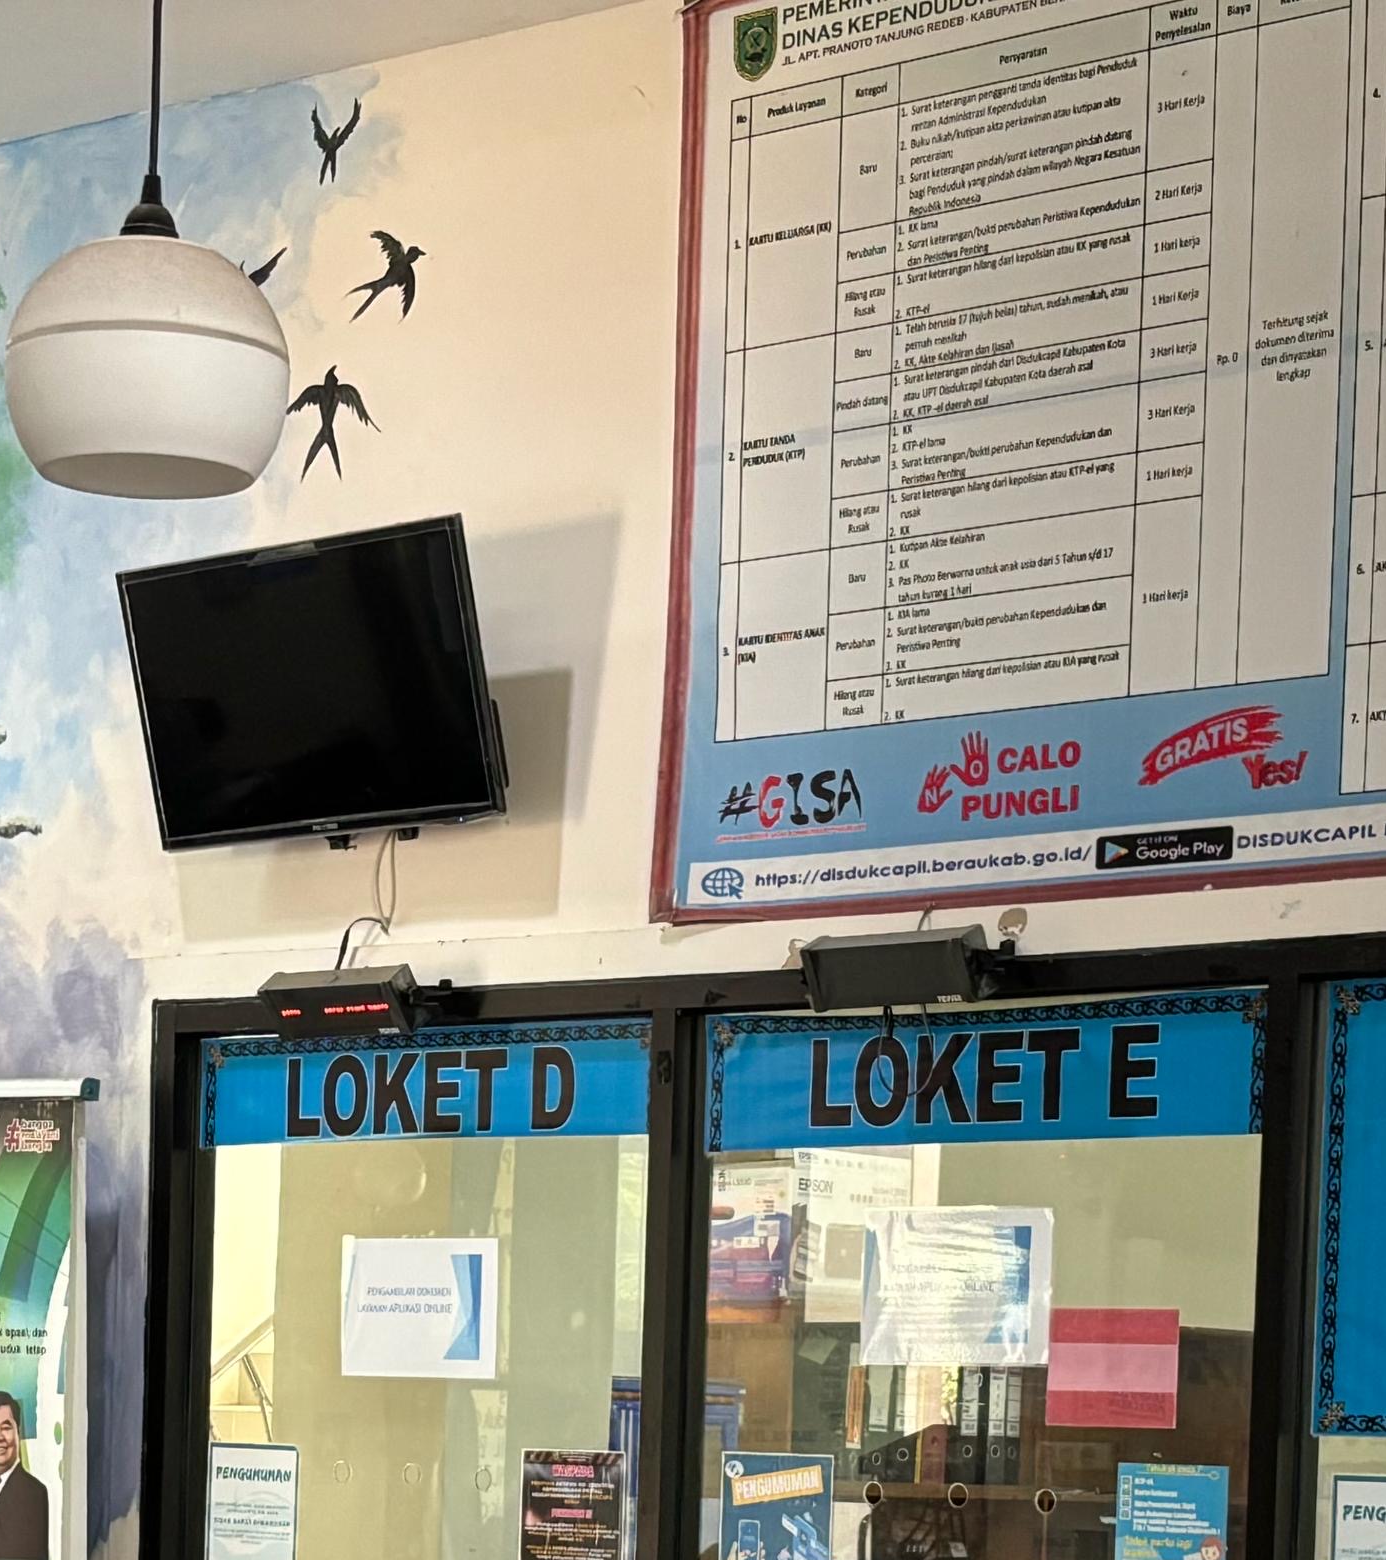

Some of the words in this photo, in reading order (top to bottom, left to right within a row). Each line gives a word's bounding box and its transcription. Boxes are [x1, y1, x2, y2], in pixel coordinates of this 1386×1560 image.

[782, 56, 796, 66] JL.
[799, 50, 820, 62] APT.
[823, 38, 872, 56] PRANOTO
[875, 25, 925, 44] TANJUNG
[927, 16, 964, 32] REDEB
[970, 1, 1037, 22] KABUPATEN
[783, 22, 842, 50] DINAS
[999, 47, 1048, 65] Persyaratan
[997, 740, 1081, 775] CALO
[1155, 716, 1249, 772] GRATIS
[1242, 750, 1310, 790] Yes!
[719, 769, 861, 828] #GISA
[961, 784, 1080, 822] PUNGLI
[1135, 842, 1190, 861] Google
[1193, 840, 1225, 857] Play
[1237, 824, 1377, 850] DISDUKCAPIL
[808, 1027, 1082, 1129] LOKET
[1108, 1022, 1161, 1119] E
[285, 1046, 509, 1140] LOKET
[529, 1044, 577, 1132] D
[797, 1176, 835, 1193] EPSON
[424, 1302, 453, 1314] ONLINE
[215, 1466, 292, 1484] PENGUMUMAN
[734, 1470, 820, 1500] PENGUMUMAN
